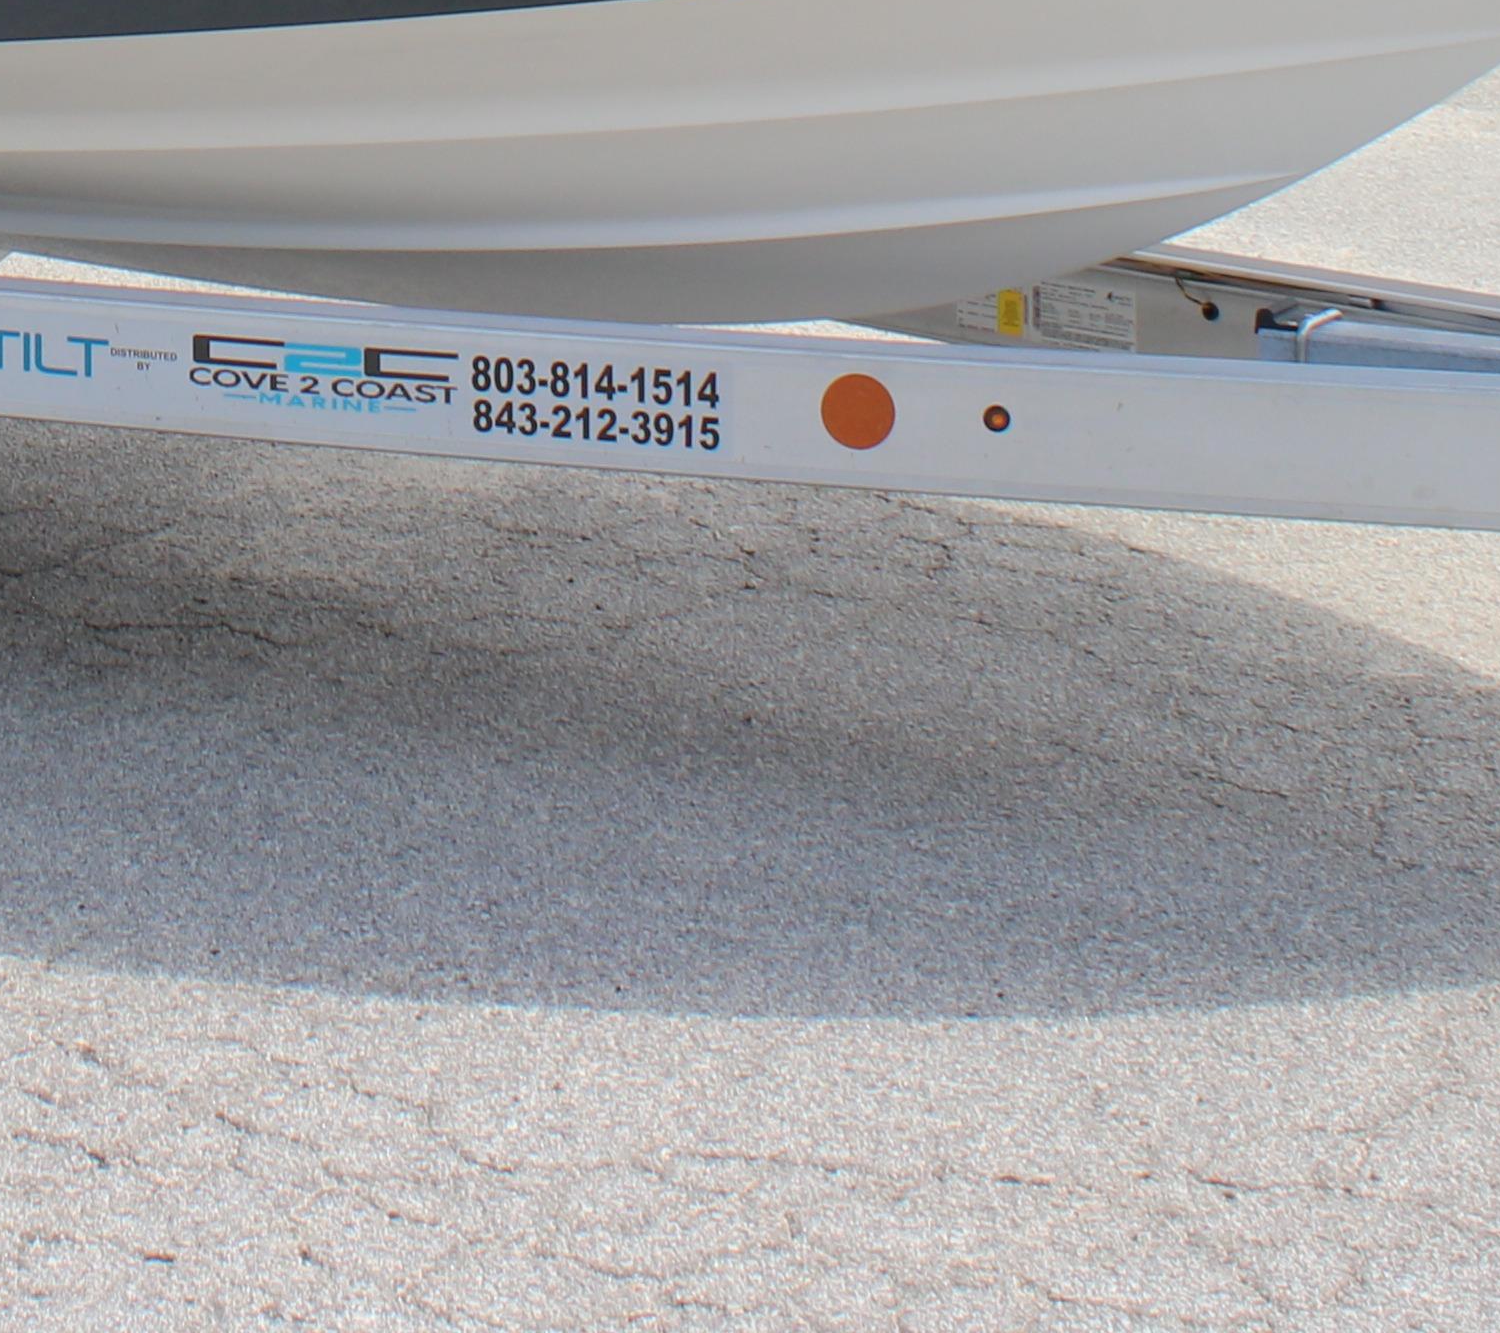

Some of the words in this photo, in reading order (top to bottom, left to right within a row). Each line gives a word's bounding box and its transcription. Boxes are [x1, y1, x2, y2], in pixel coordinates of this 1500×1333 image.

[109, 347, 178, 362] DISTRIBUTED
[136, 361, 151, 371] BY
[188, 366, 290, 393] COVE
[299, 374, 320, 394] 2
[331, 378, 459, 406] COAST
[471, 355, 720, 409] 803-814-1514
[259, 392, 382, 414] MARINE
[472, 398, 720, 451] 843-212-3915
